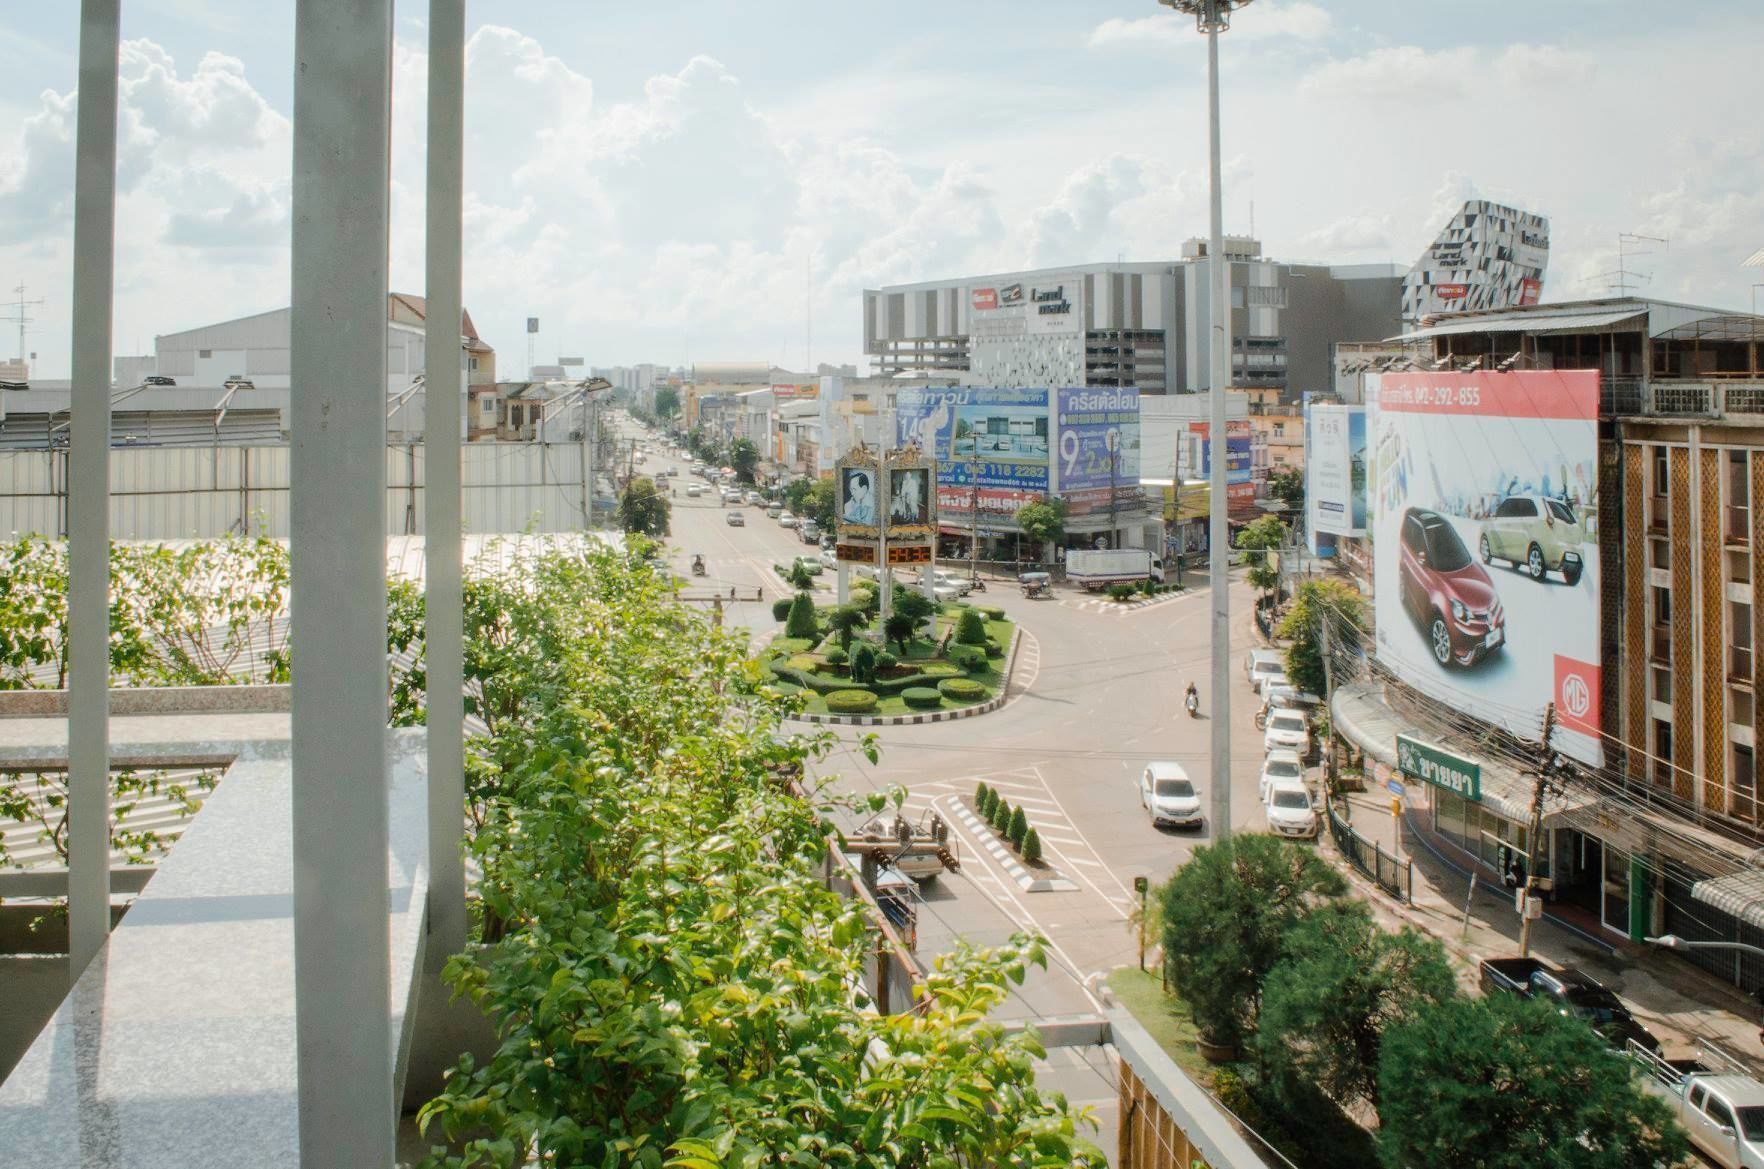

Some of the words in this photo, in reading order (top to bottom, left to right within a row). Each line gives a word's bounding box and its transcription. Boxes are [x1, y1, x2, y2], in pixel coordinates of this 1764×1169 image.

[1432, 249, 1461, 260] Land
[1031, 286, 1062, 302] Land
[1060, 429, 1079, 476] 9
[1419, 757, 1473, 796] ขายยา
